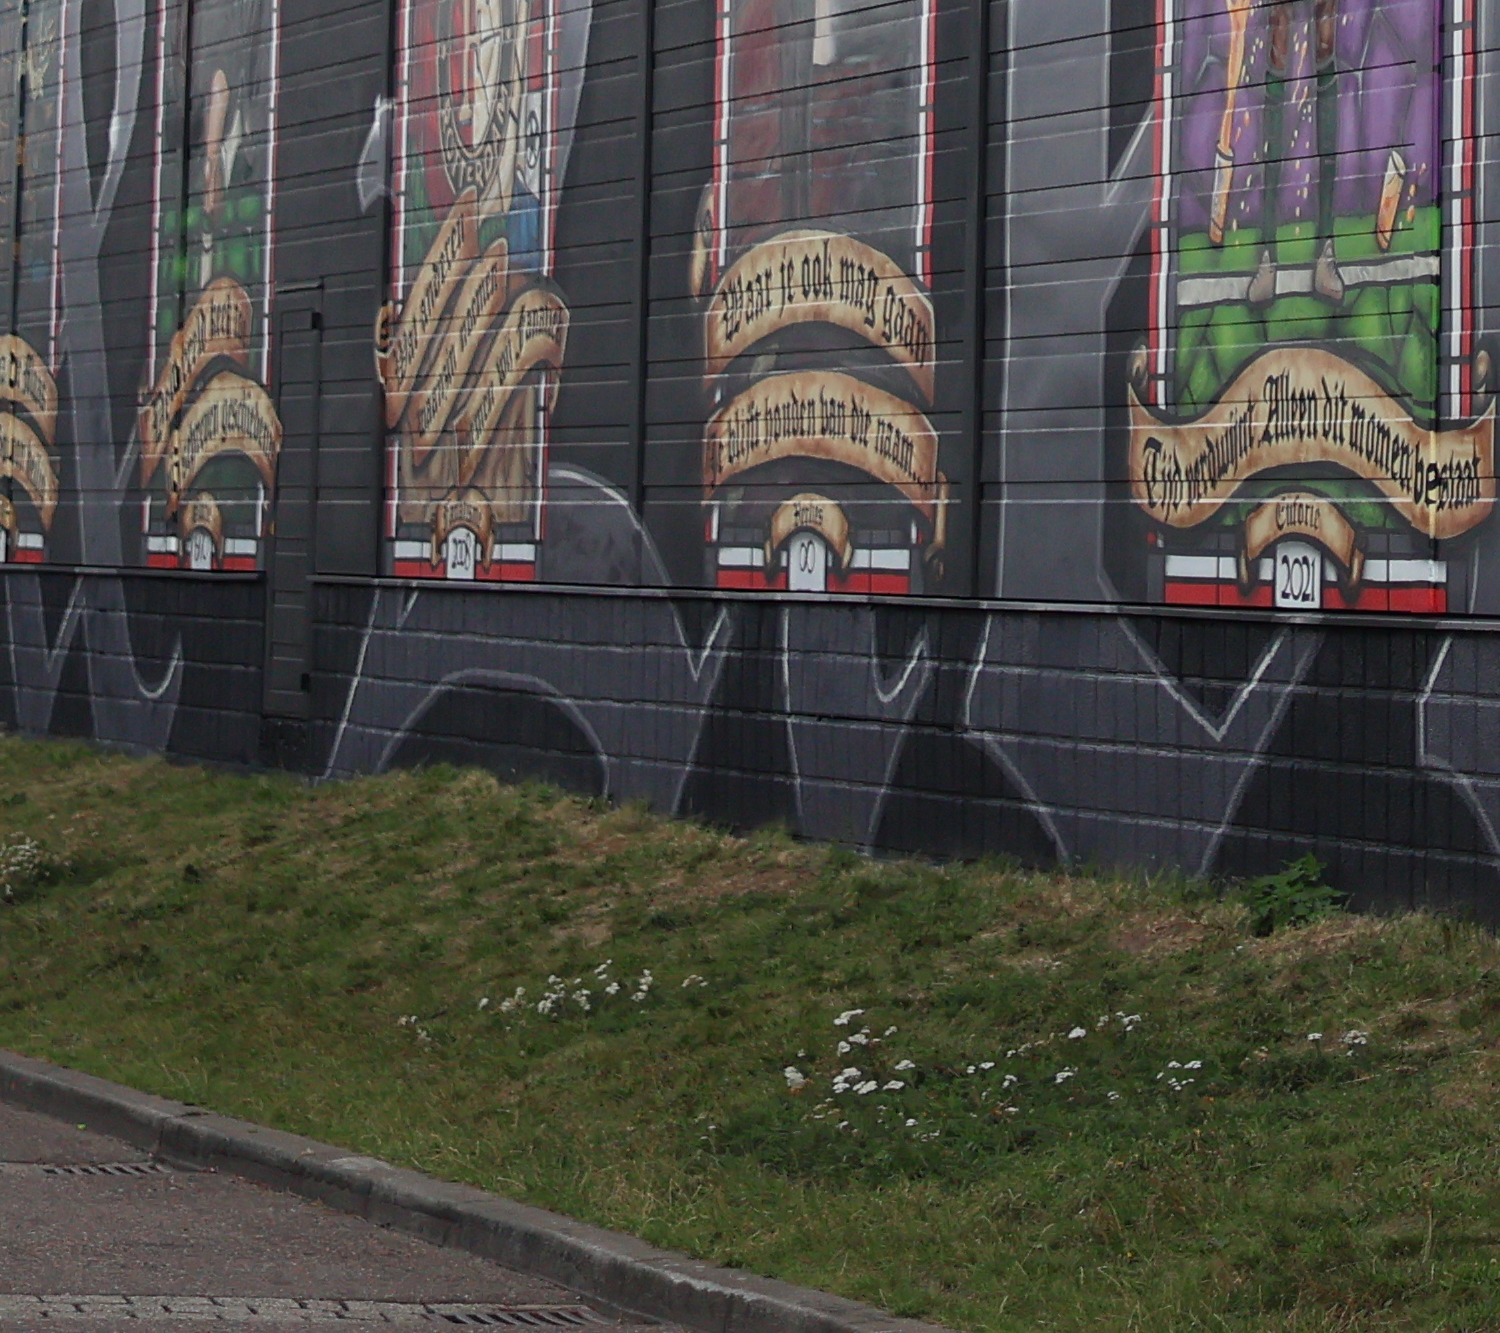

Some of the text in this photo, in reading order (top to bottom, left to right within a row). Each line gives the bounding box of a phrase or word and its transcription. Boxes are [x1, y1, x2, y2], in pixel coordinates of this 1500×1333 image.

[720, 239, 928, 369] Waar je ook mag gaan
[763, 389, 817, 454] houden
[819, 384, 846, 436] van
[850, 393, 872, 446] die
[1142, 436, 1184, 521] Tijd
[1258, 367, 1319, 447] Alleen
[1320, 374, 1346, 447] dit
[1280, 555, 1316, 603] 2021
